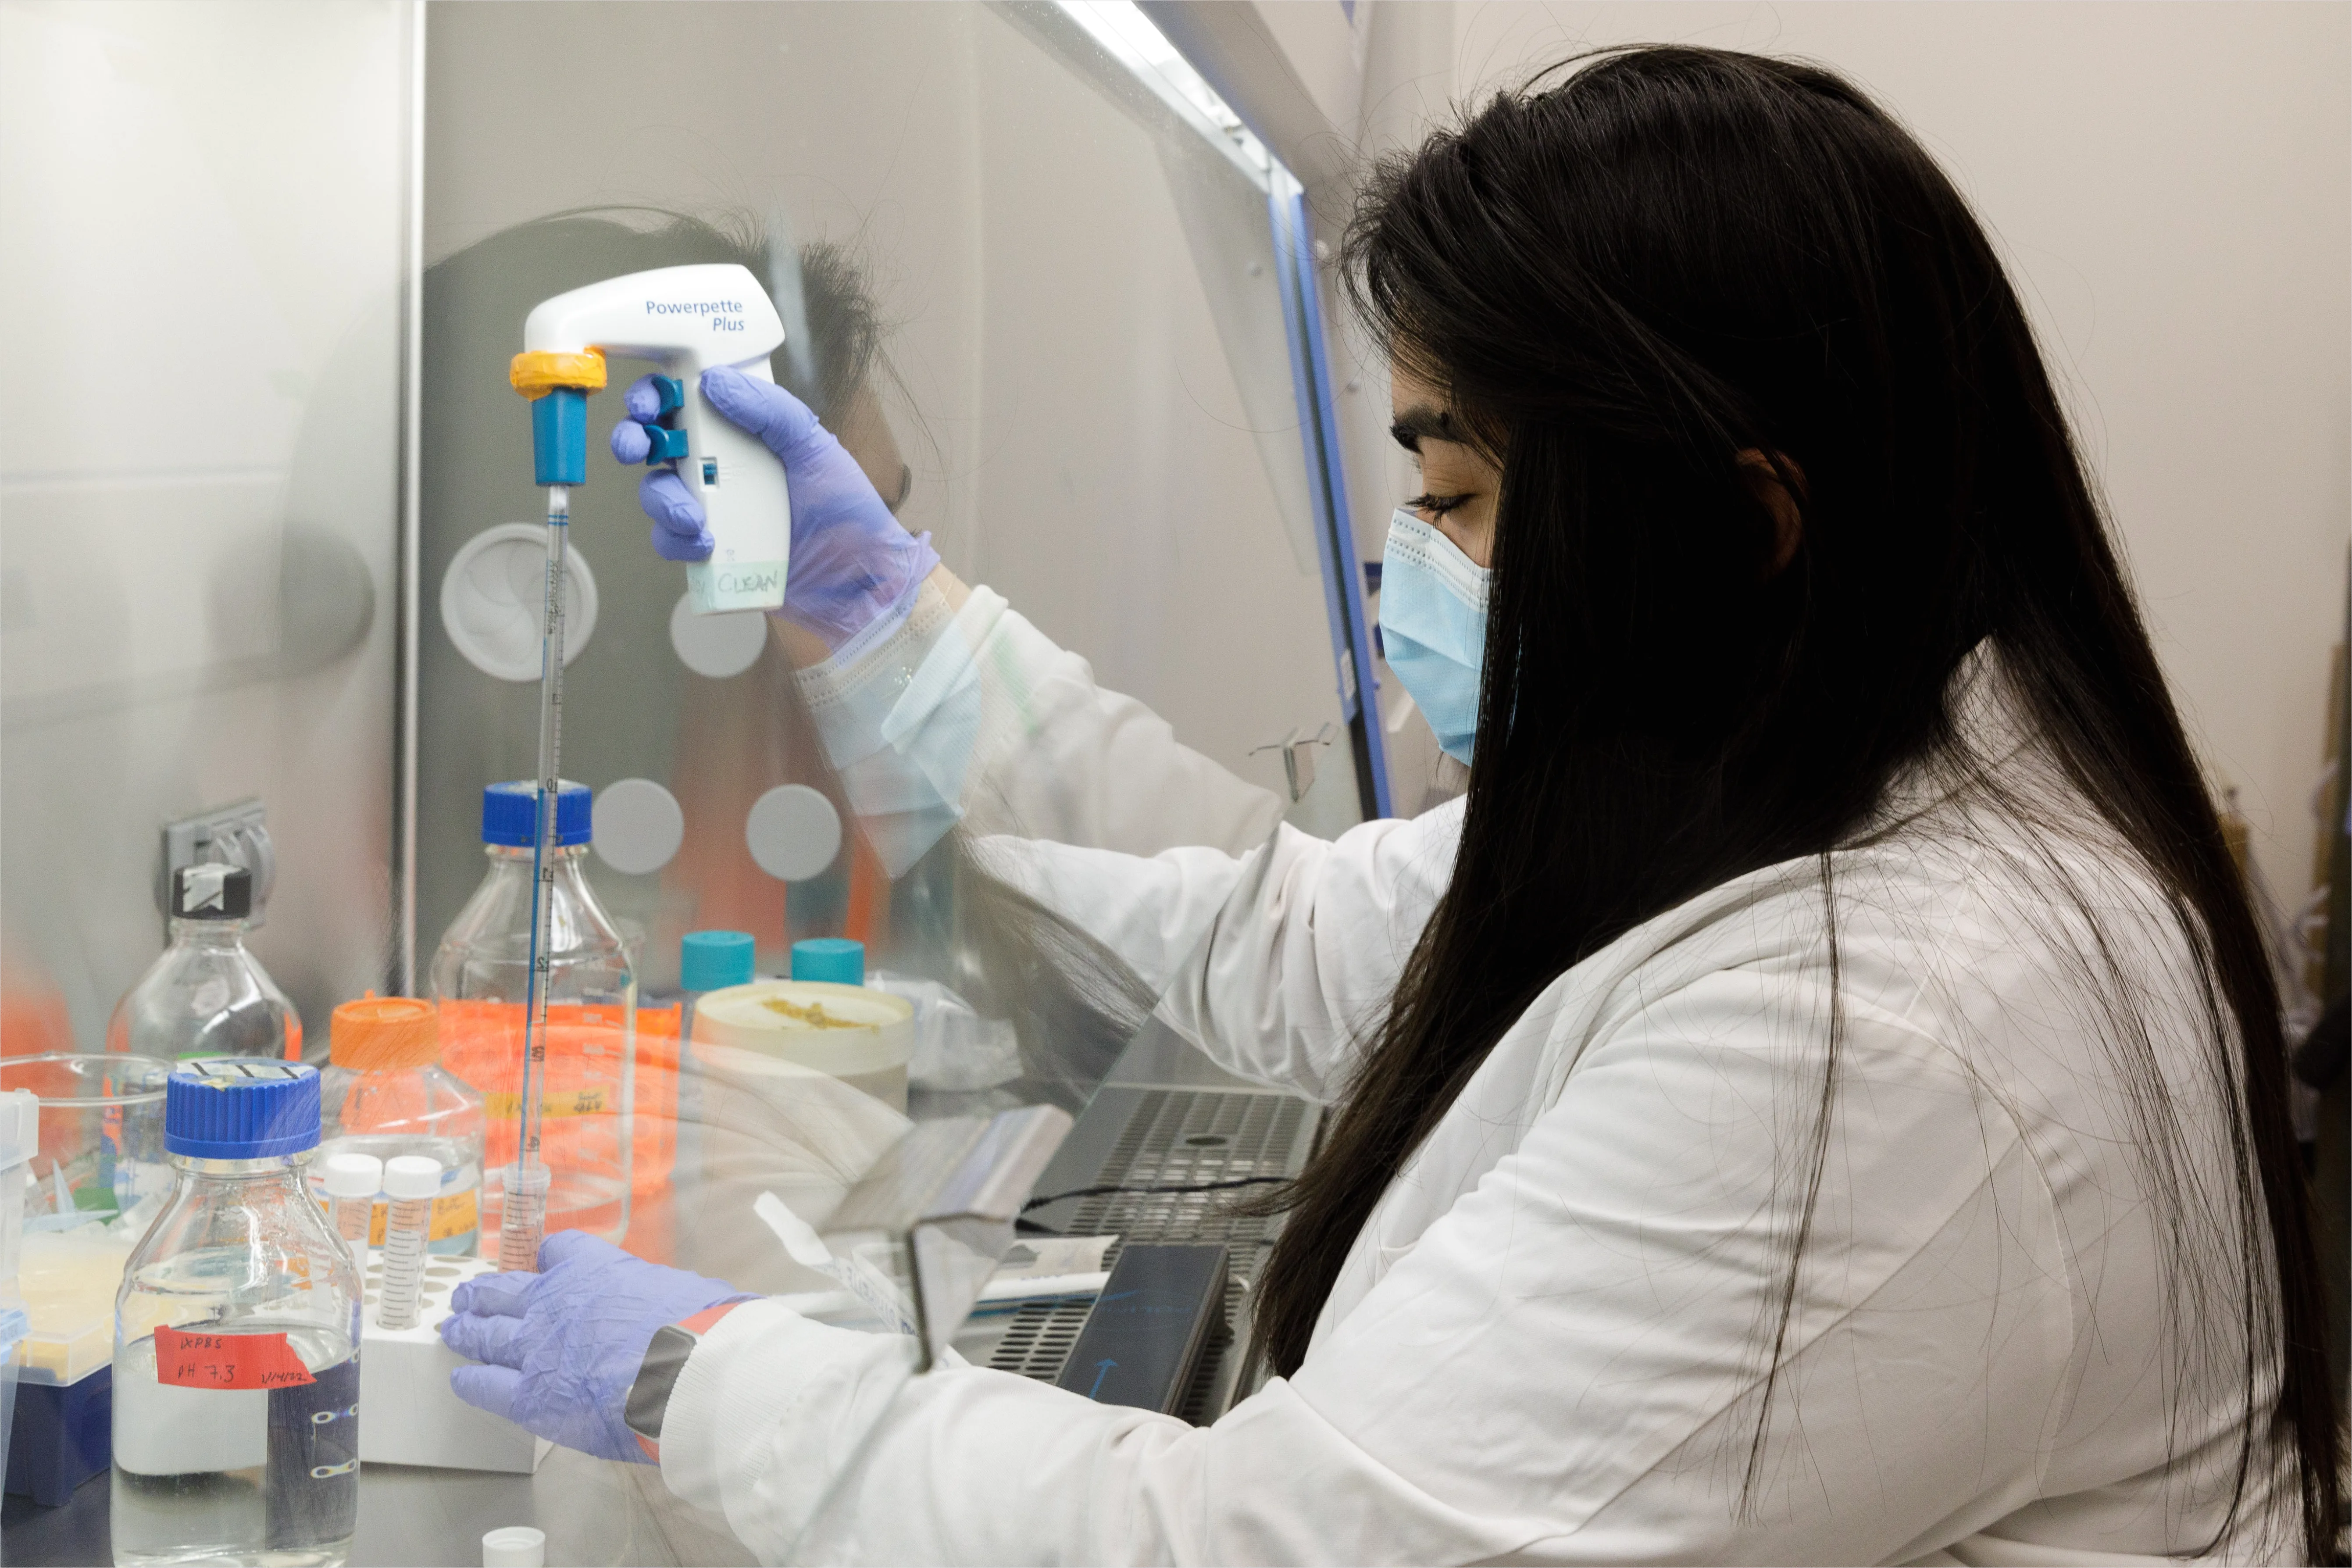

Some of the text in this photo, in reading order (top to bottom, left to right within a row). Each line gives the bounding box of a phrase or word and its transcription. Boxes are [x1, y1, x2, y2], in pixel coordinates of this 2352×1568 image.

[646, 300, 742, 317] Powerpette
[713, 317, 745, 332] Plus
[718, 570, 778, 594] CLEAN
[204, 1364, 235, 1383] 7.3
